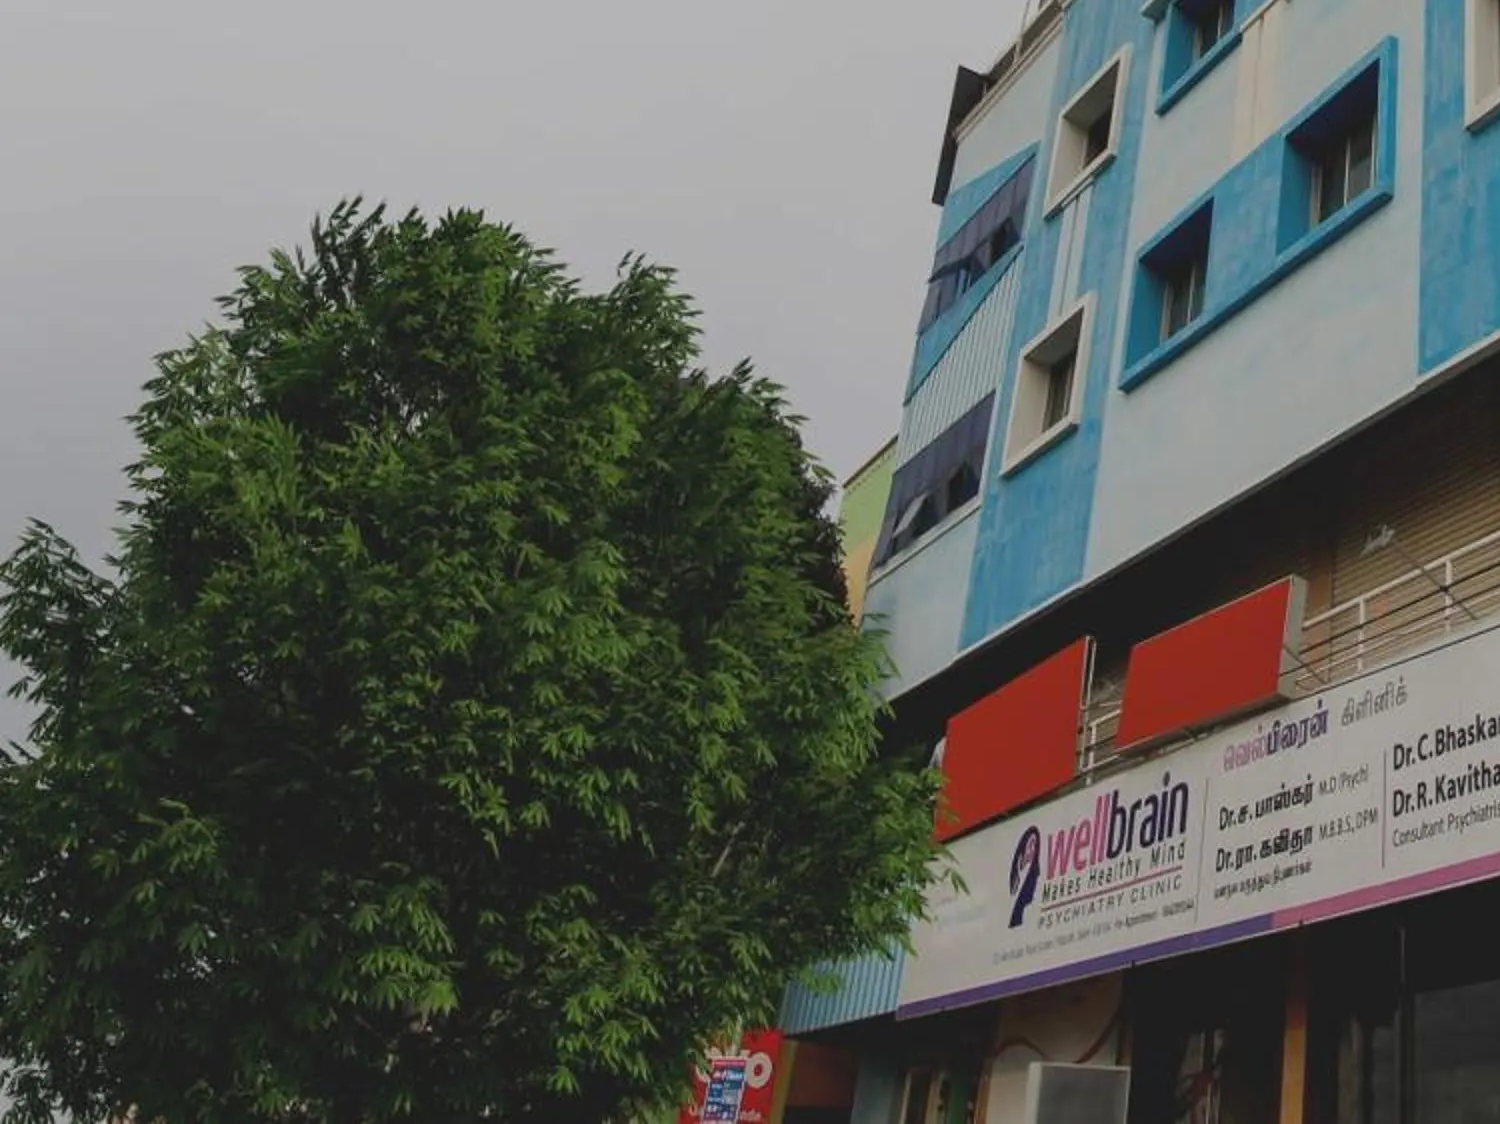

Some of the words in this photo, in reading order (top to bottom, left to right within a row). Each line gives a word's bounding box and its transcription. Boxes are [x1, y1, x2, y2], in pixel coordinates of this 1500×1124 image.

[1046, 772, 1189, 881] wellbrain
[1392, 817, 1444, 848] Consultant
[1041, 877, 1081, 903] Makes
[1089, 858, 1142, 886] Healthy
[1151, 841, 1185, 867] Mind
[1038, 891, 1125, 929] PSYCHIATRY
[1130, 876, 1182, 904] CLINIC
